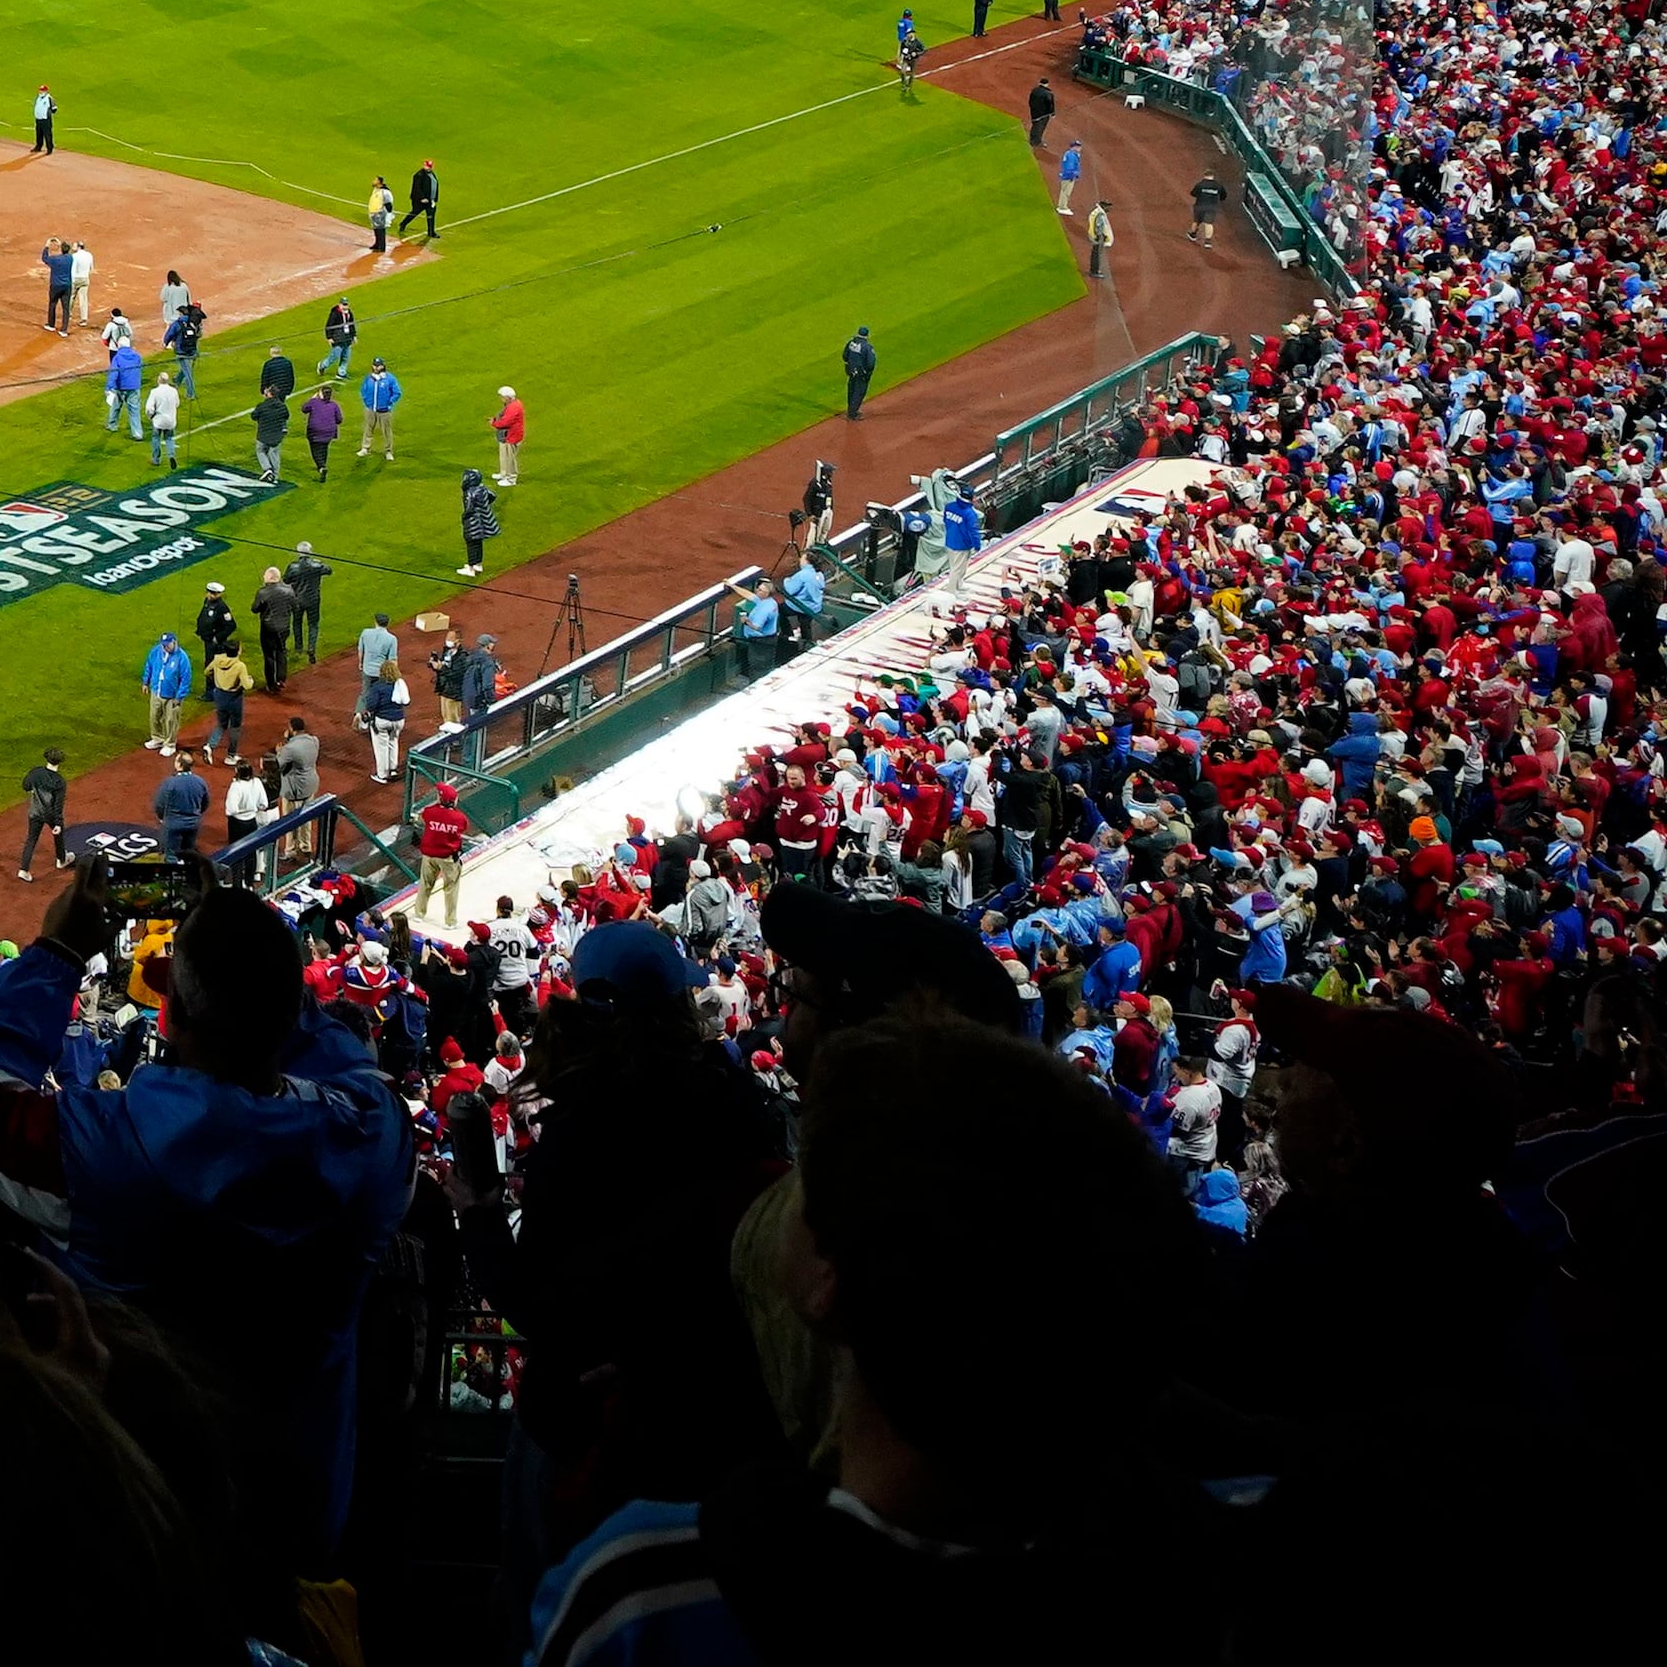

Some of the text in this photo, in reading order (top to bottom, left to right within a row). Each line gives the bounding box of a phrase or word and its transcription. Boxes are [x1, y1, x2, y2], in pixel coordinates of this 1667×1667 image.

[82, 535, 205, 586] loanDepot
[429, 820, 459, 833] STAFF
[495, 940, 521, 959] 20
